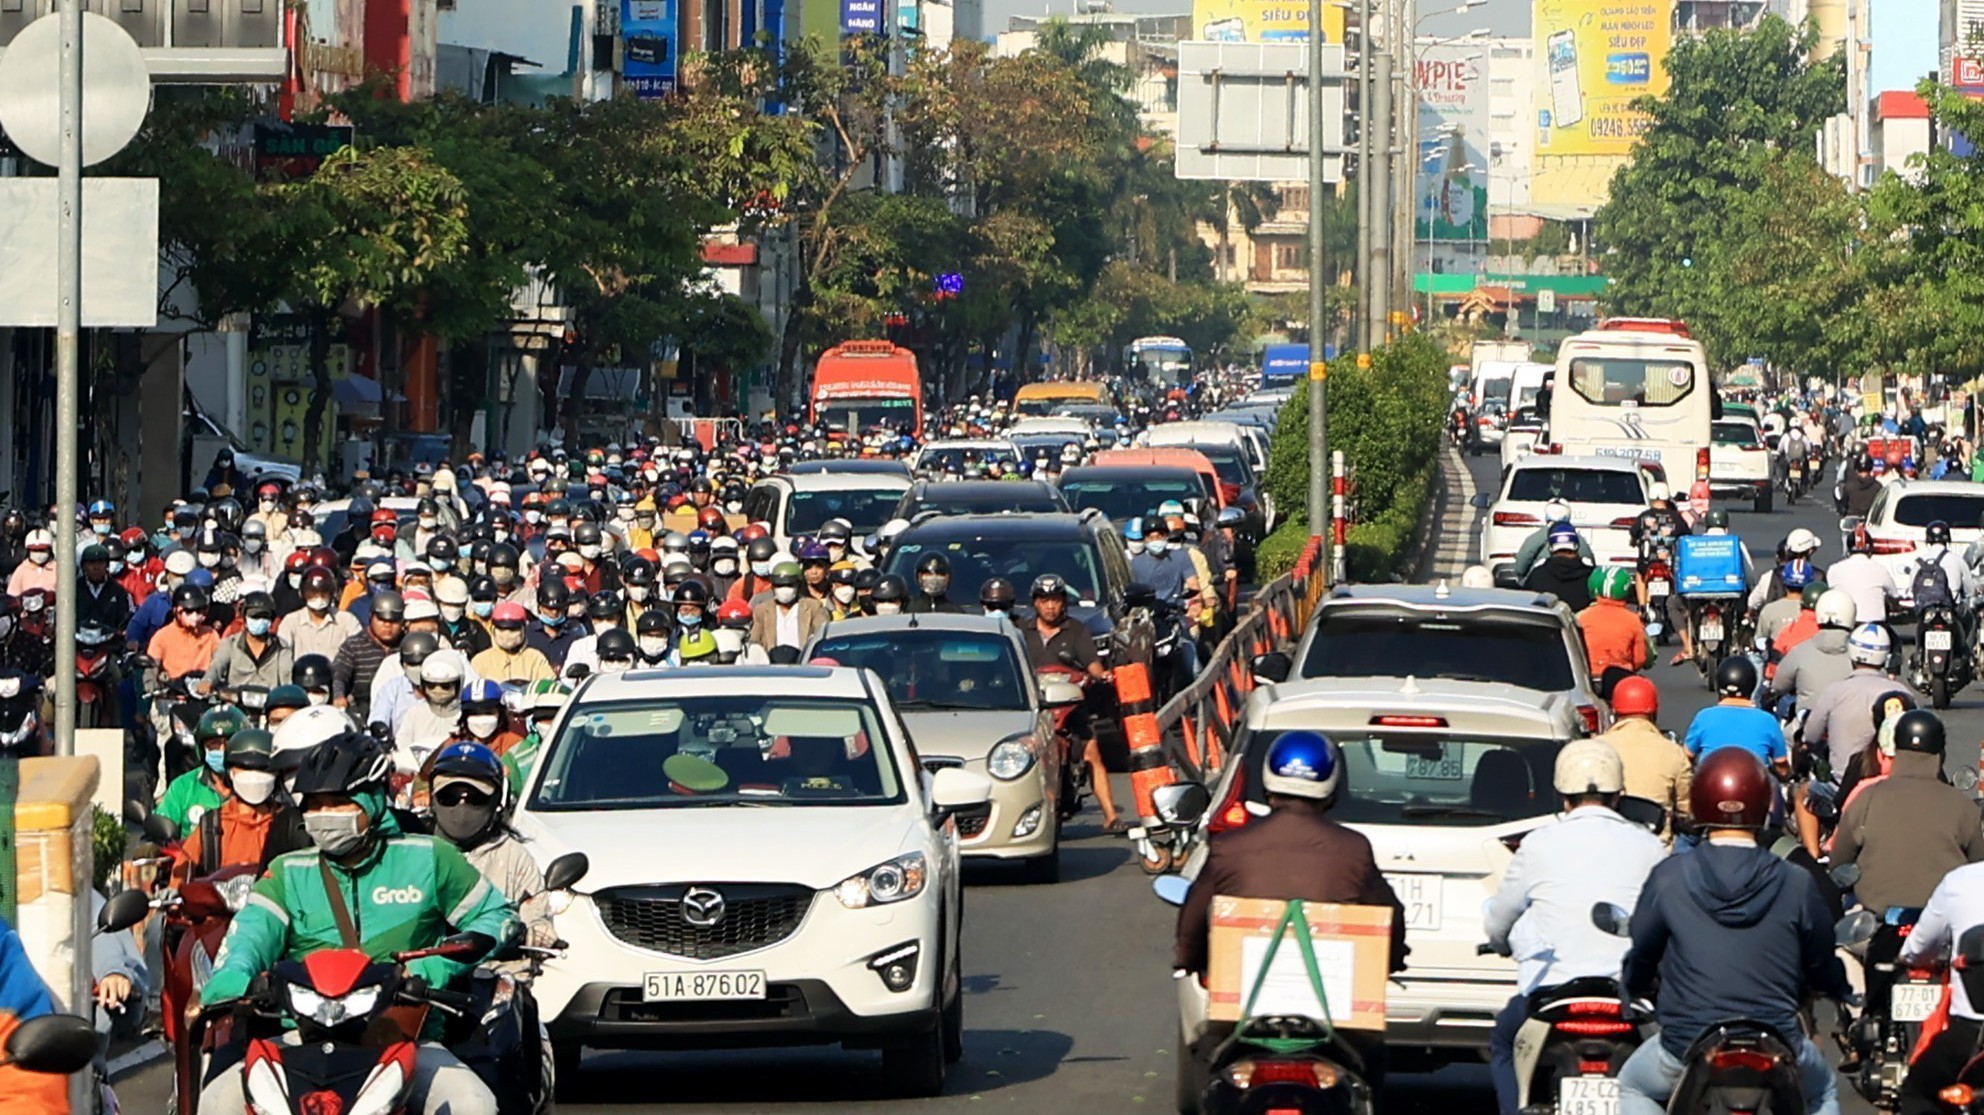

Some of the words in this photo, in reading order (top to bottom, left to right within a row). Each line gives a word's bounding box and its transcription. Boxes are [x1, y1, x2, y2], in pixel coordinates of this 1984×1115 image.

[1262, 8, 1291, 21] SIÊU
[372, 884, 423, 905] Grab
[648, 973, 760, 997] 51A-876.02
